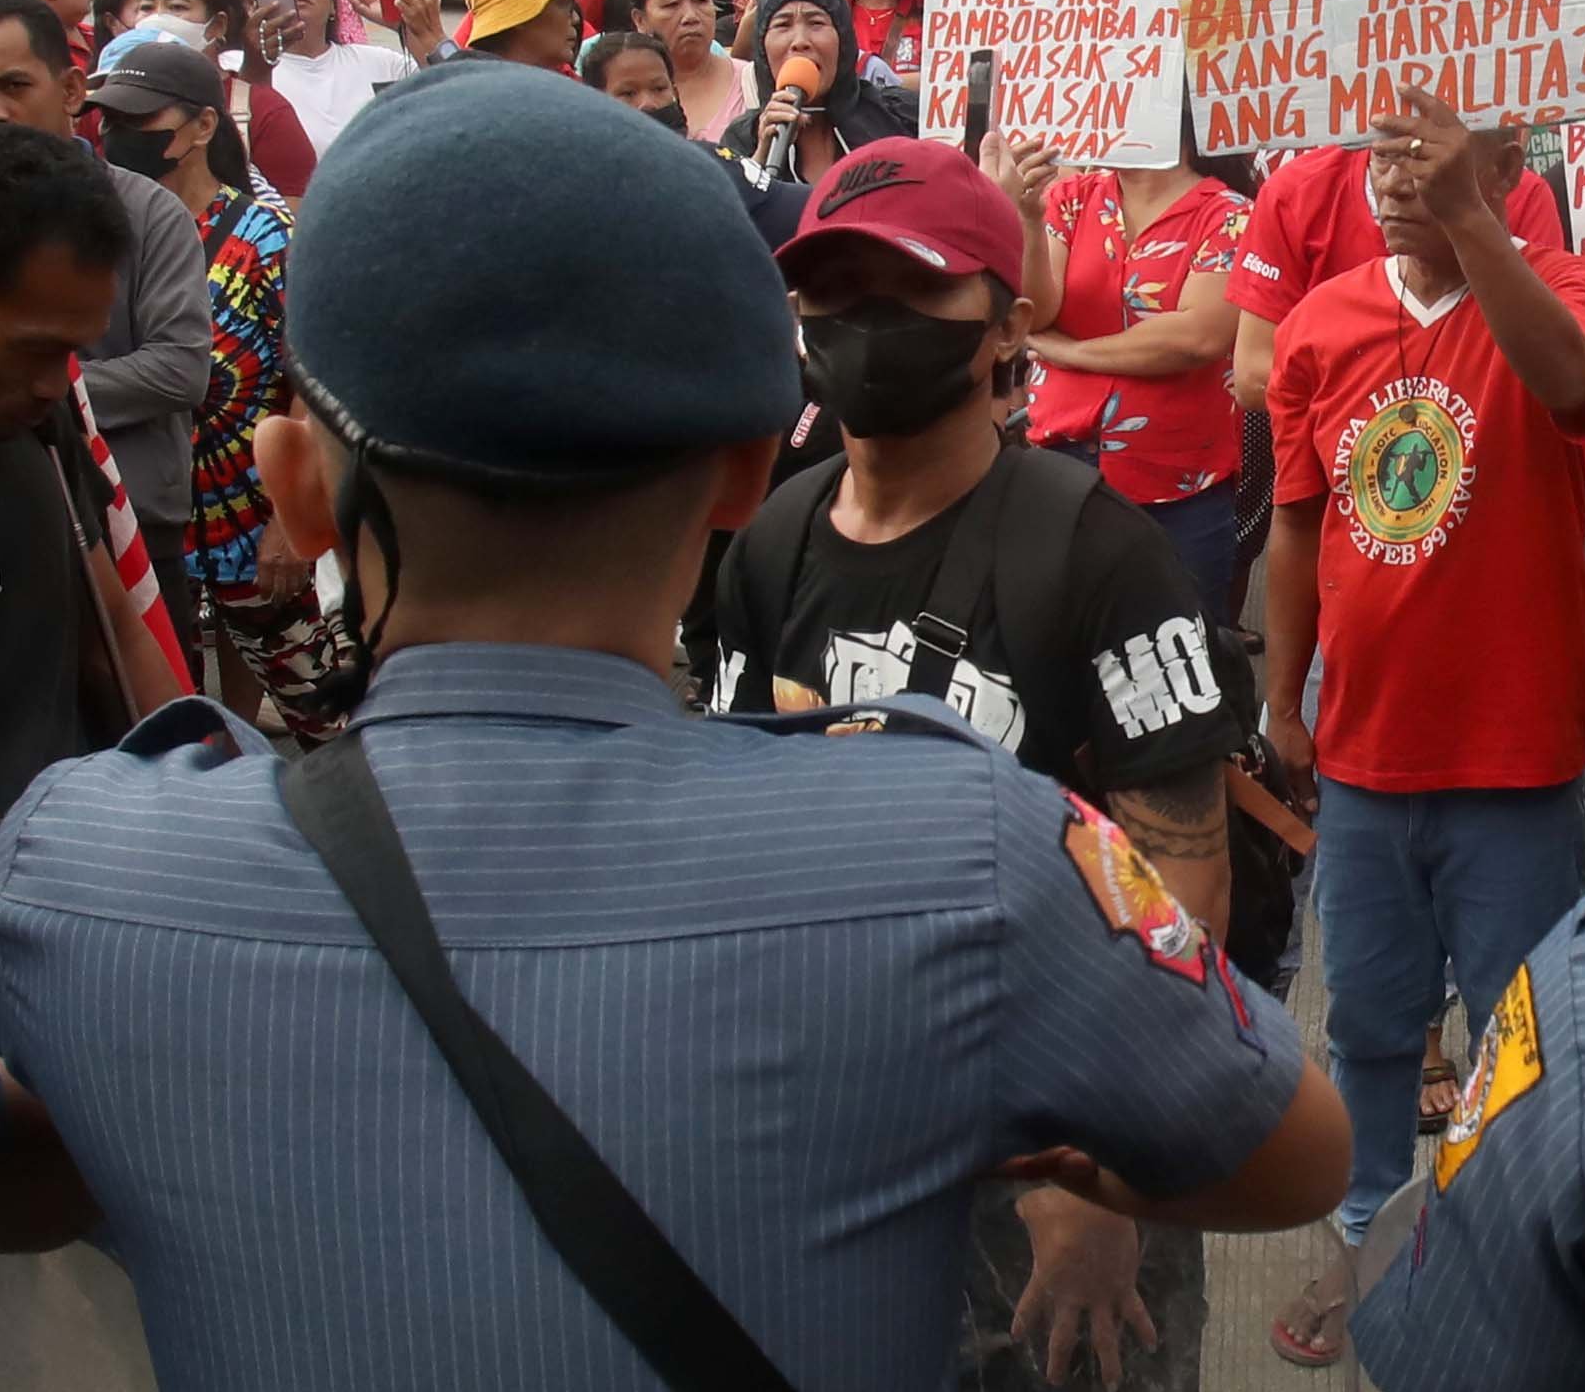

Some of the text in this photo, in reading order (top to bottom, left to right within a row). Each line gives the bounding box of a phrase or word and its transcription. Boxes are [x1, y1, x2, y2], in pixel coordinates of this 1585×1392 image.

[928, 6, 1182, 49] PAMBOBOMBA AT
[1124, 45, 1161, 78] SA
[1196, 30, 1327, 96] KANG
[1207, 86, 1305, 150] ANG
[831, 160, 905, 198] NIKE
[1333, 417, 1367, 516] CAINTA
[1448, 465, 1475, 525] DAY
